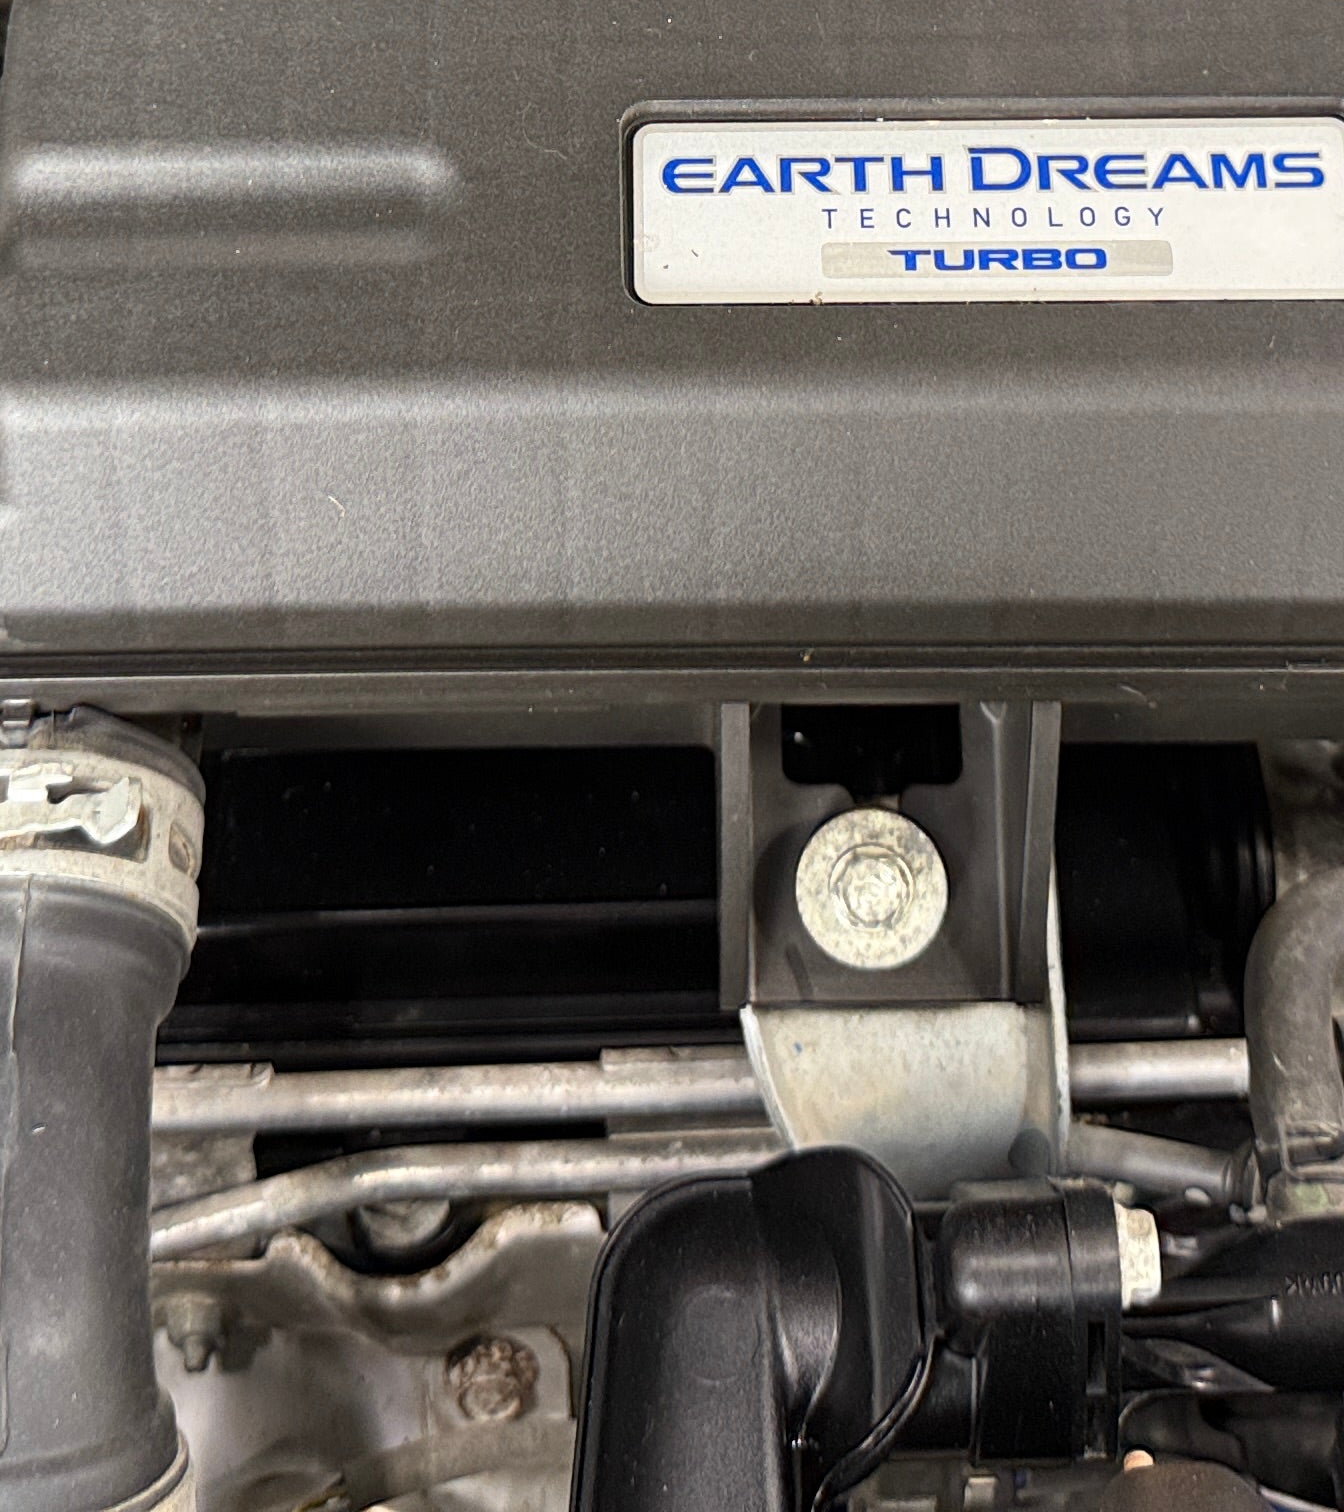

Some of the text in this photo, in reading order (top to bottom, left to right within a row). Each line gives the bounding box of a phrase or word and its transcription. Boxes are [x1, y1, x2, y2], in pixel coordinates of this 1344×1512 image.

[661, 145, 1325, 193] EARTH DREAMS
[822, 207, 1166, 228] TECHNOLOGY
[887, 248, 1107, 271] TURBO
